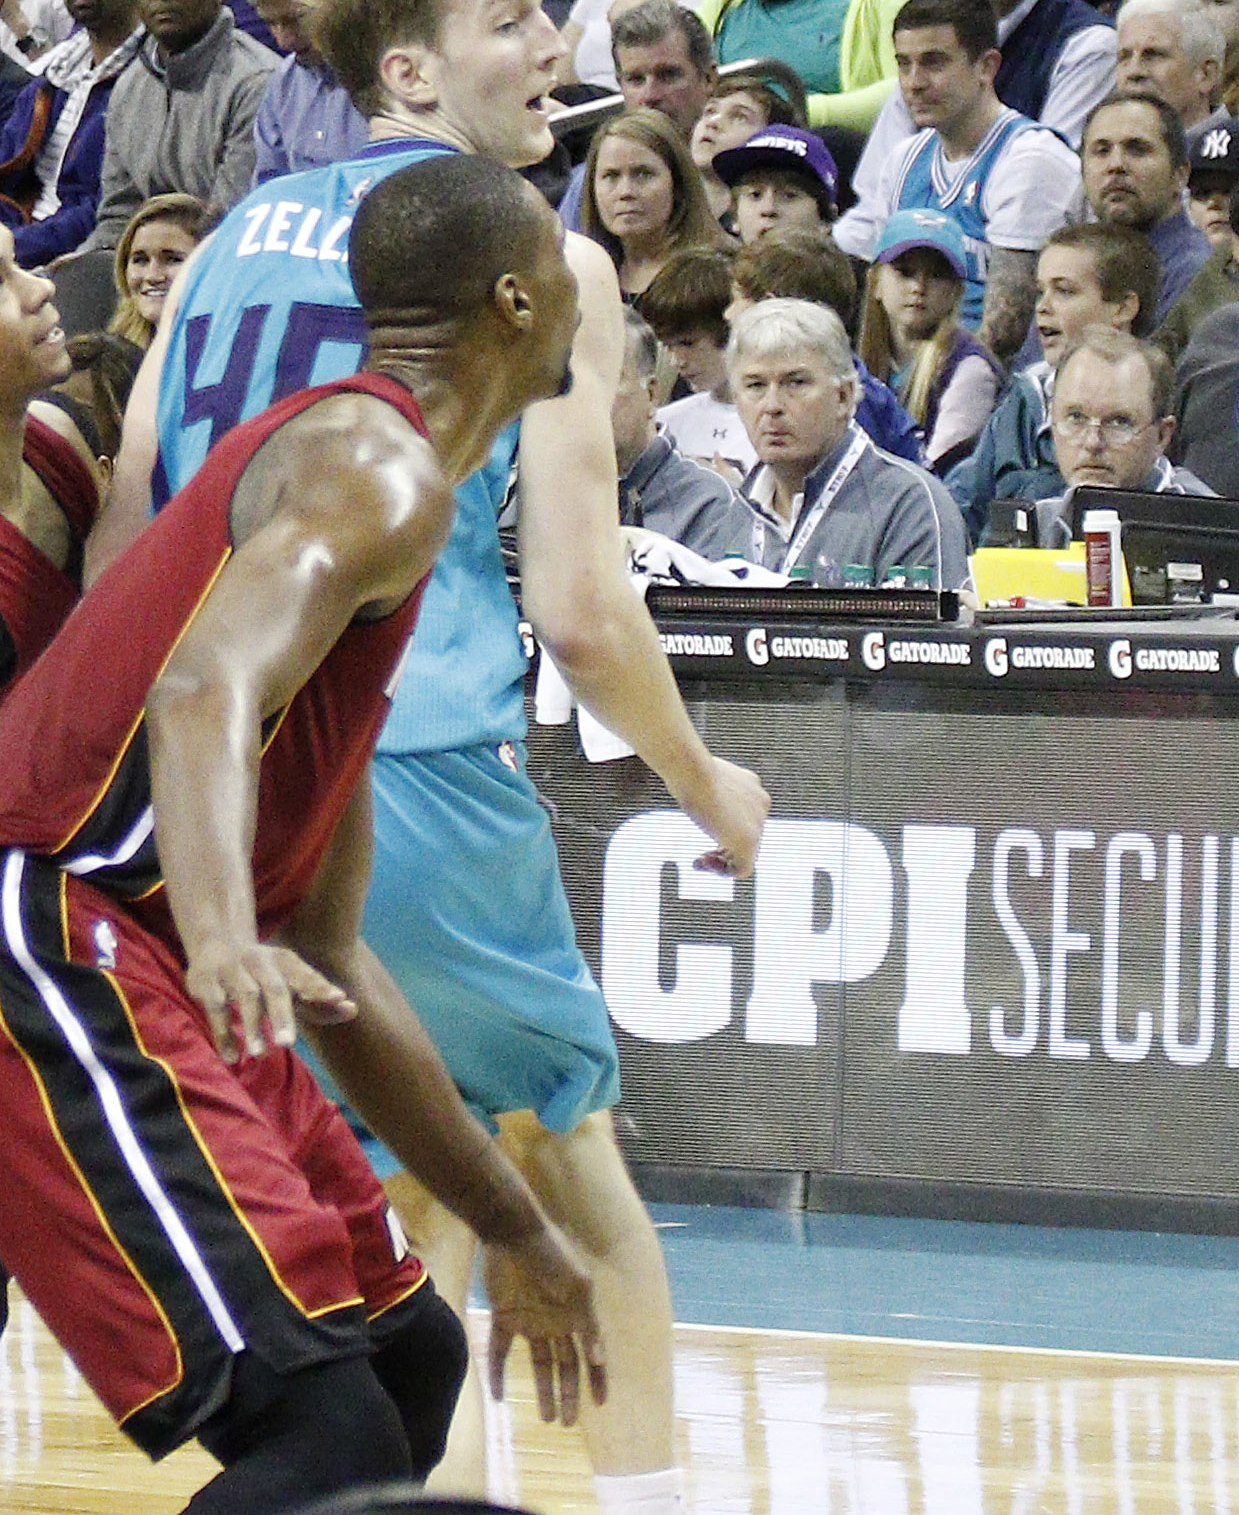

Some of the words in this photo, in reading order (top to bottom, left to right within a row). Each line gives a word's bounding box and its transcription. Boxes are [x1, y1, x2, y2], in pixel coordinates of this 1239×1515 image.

[1201, 128, 1232, 160] NY
[236, 201, 352, 262] ZELL
[746, 628, 769, 665] G
[862, 632, 886, 671] G
[888, 640, 971, 665] GATORADE
[984, 638, 1009, 677] G
[1012, 646, 1095, 669] GATORADE
[1109, 640, 1132, 679] G
[1135, 648, 1220, 672] GATORADE
[601, 808, 976, 1054] CPI
